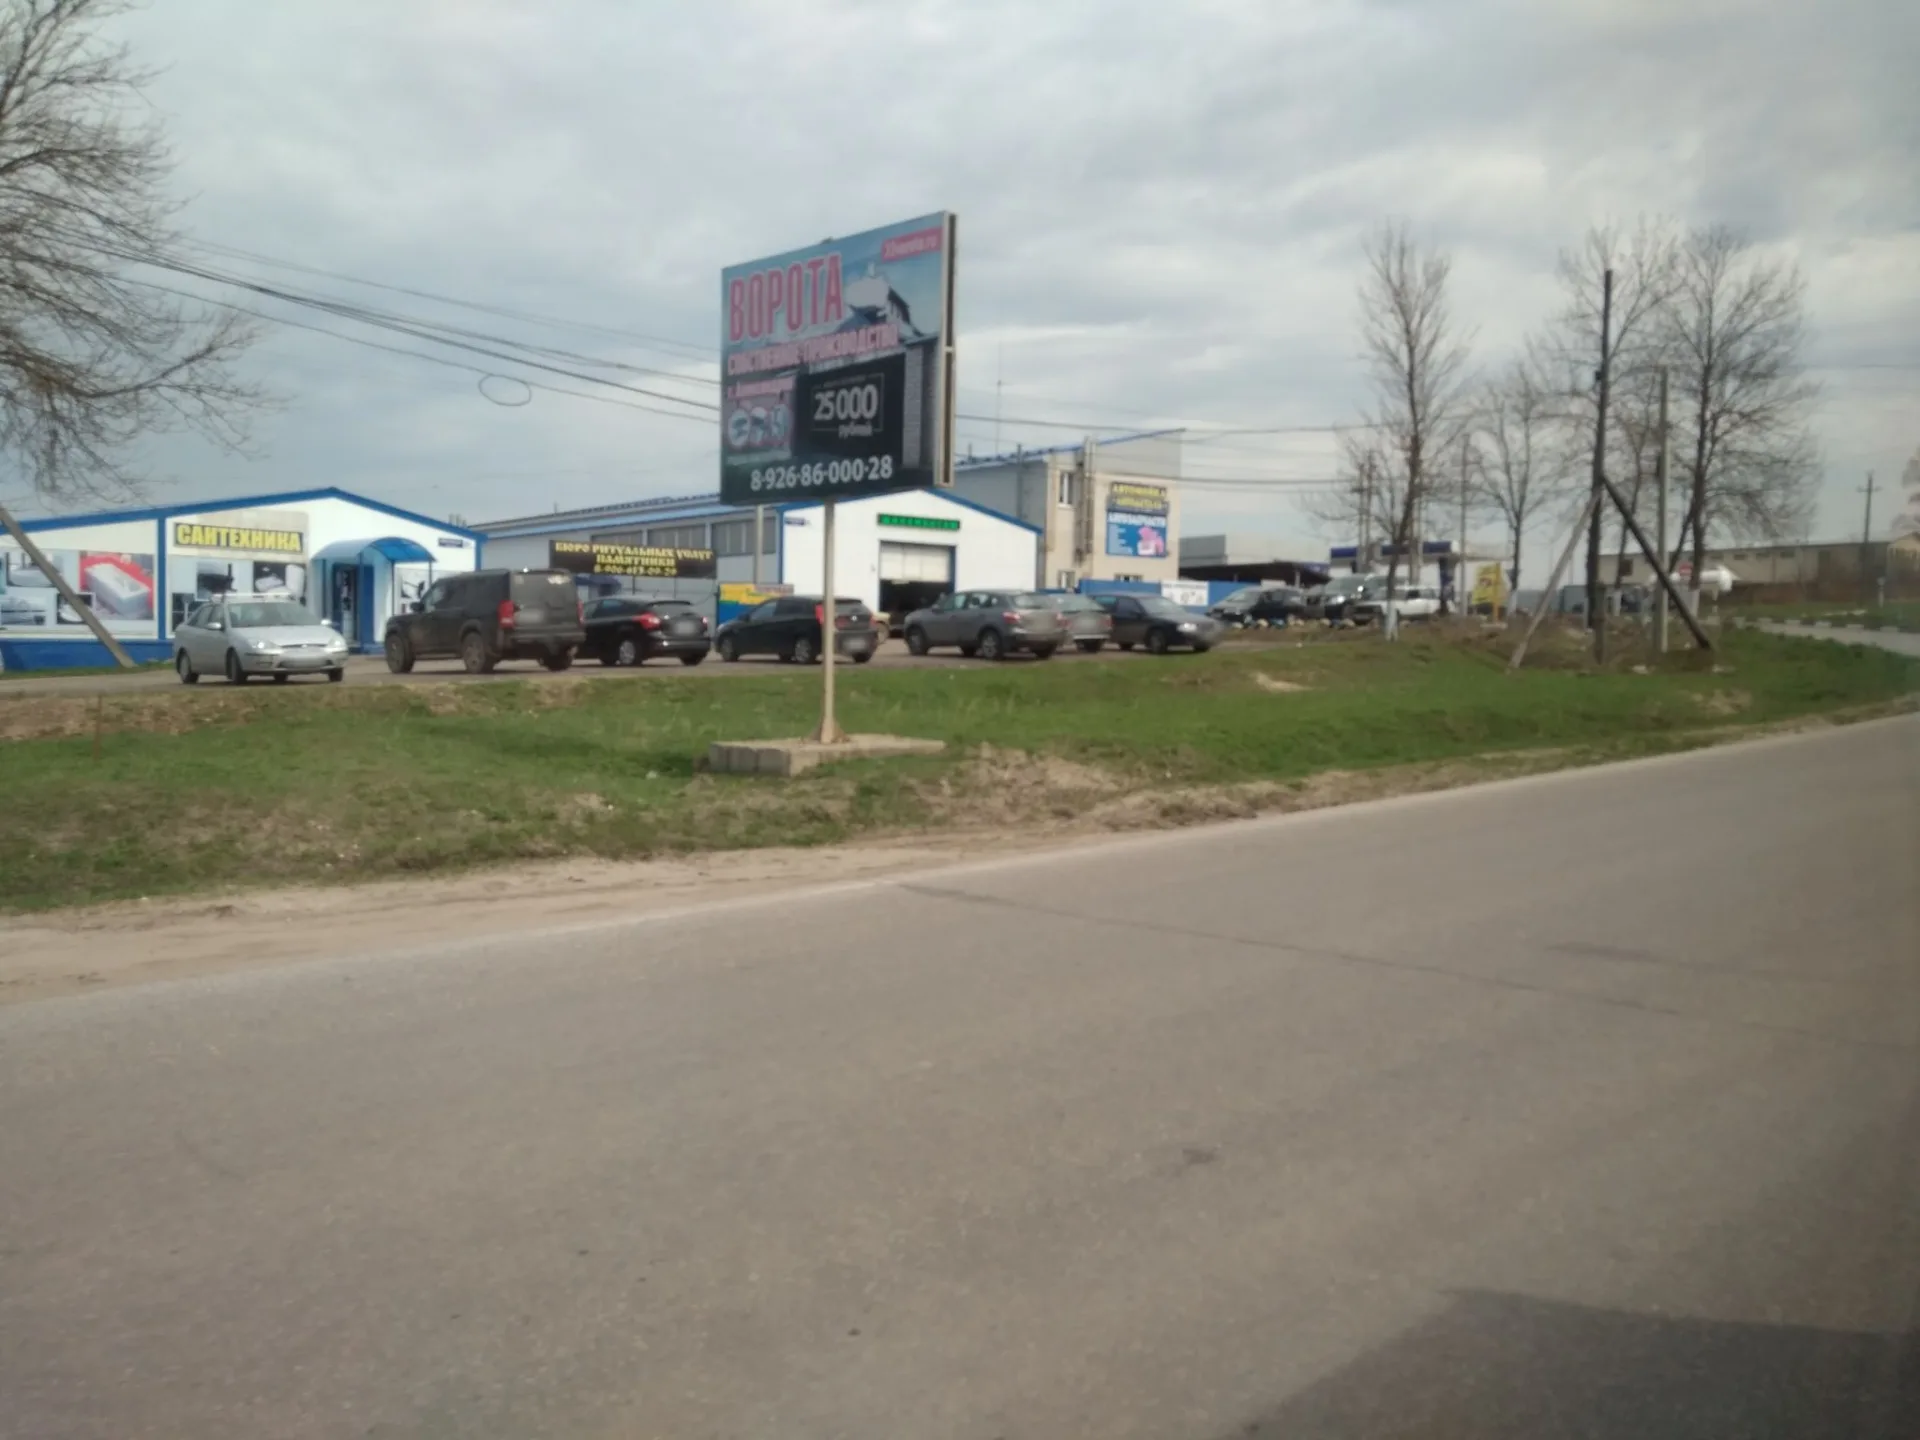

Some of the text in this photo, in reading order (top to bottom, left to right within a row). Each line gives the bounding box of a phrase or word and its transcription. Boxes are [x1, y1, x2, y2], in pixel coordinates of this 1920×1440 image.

[729, 253, 844, 342] ВОРОТА
[177, 523, 301, 552] САНТЕХНИКА
[555, 542, 590, 552] БЮРО
[592, 544, 674, 557] РИТУАЛЬНЫХ
[596, 554, 676, 567] ПАМЯТНИКИ
